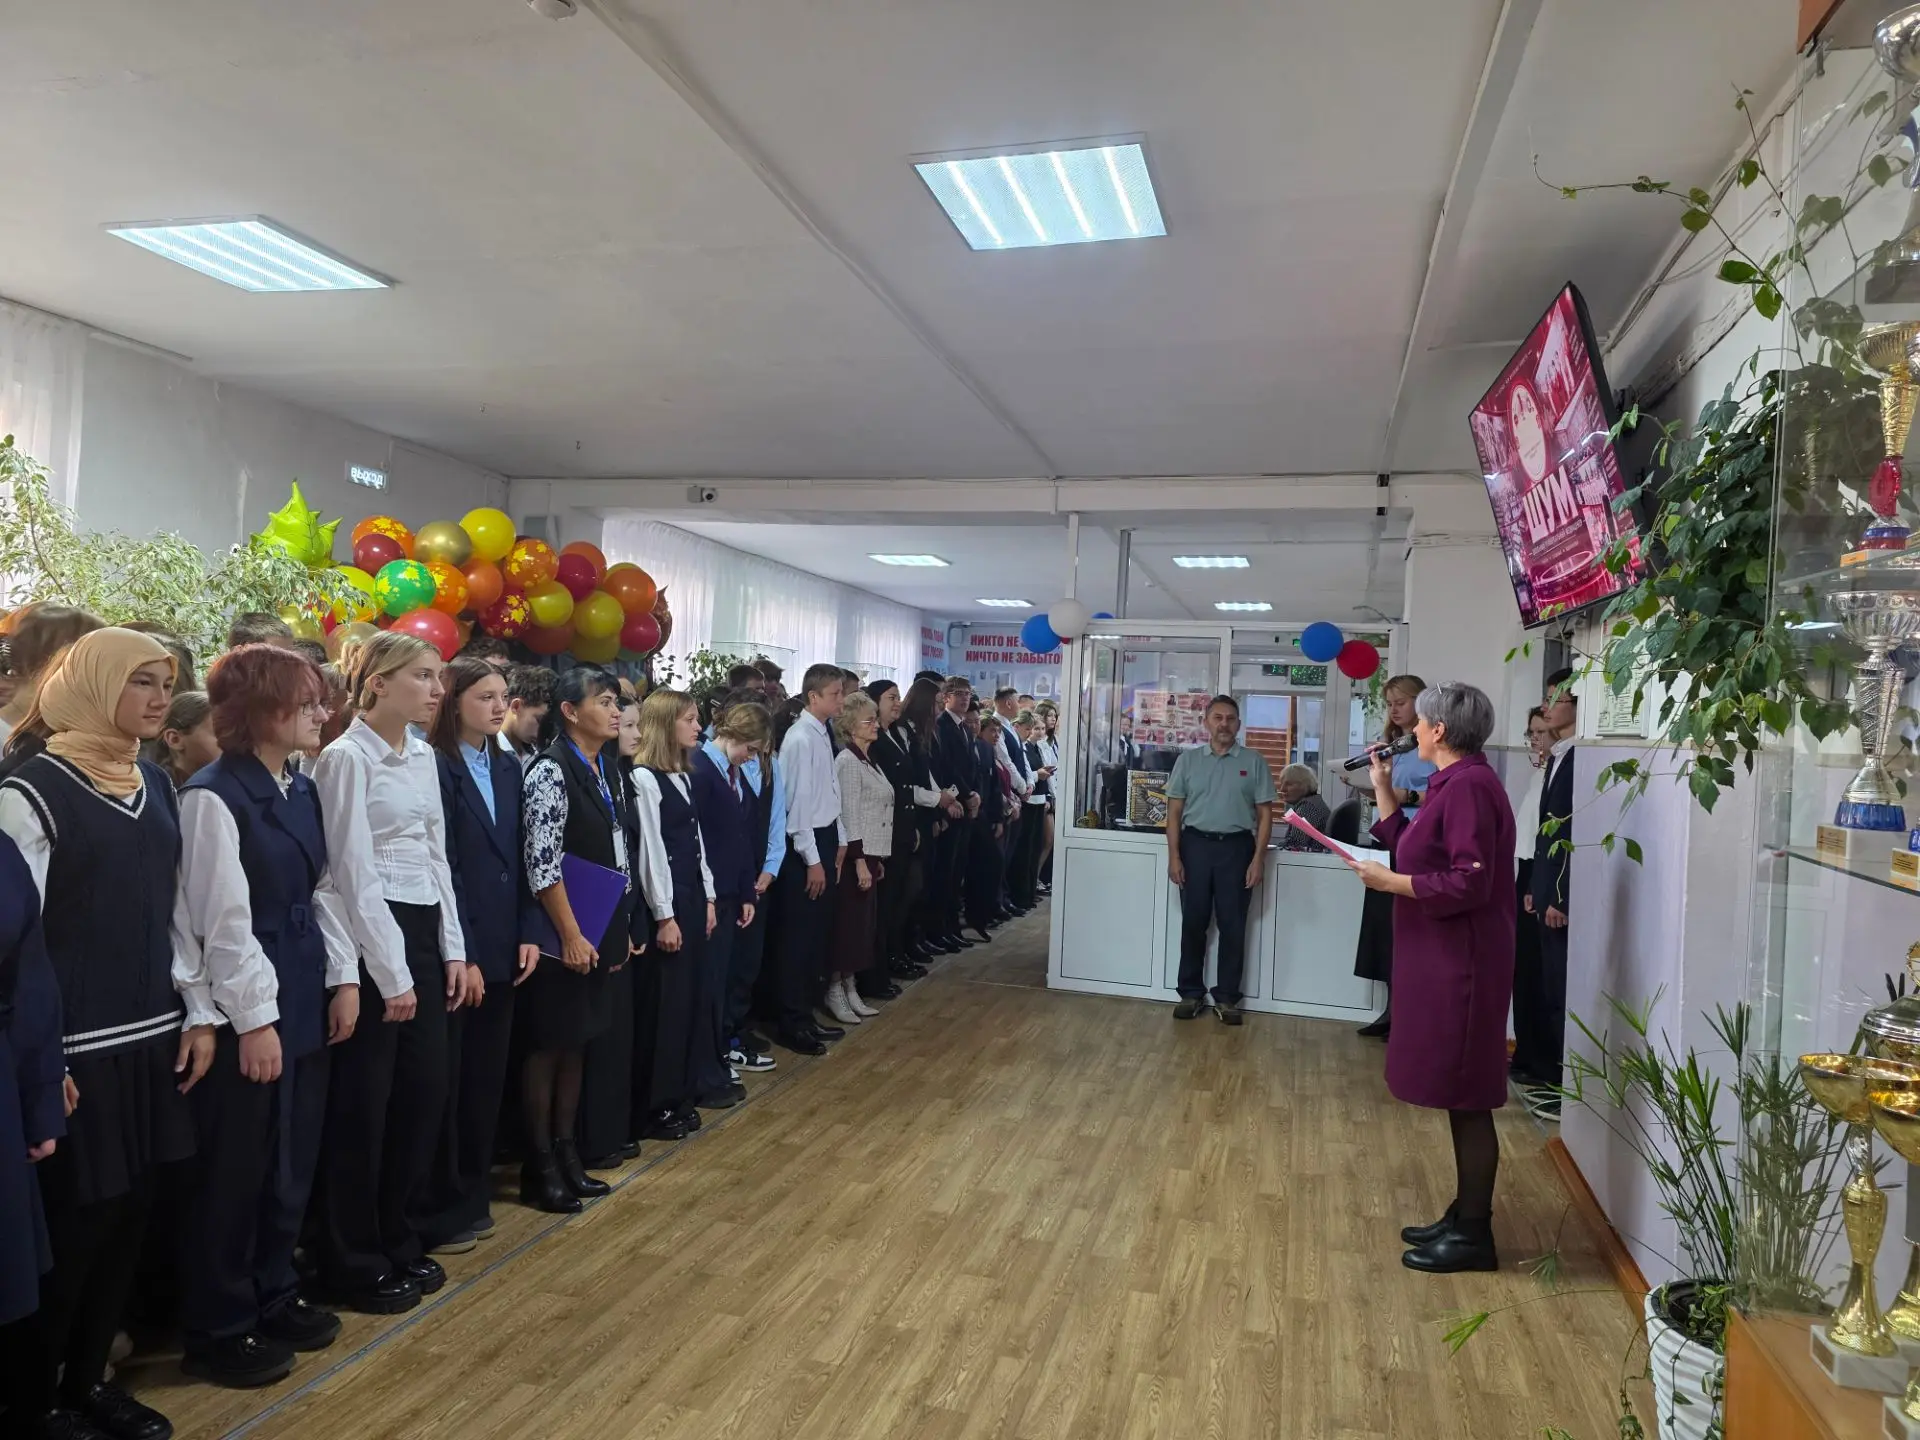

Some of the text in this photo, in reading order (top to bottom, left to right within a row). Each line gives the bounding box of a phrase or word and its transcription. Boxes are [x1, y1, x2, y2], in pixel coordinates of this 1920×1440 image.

[351, 467, 384, 486] ВЫХОД
[1522, 464, 1579, 544] ШУМ
[970, 634, 1004, 647] НИКТО
[1006, 635, 1019, 648] НЕ
[966, 650, 999, 663] НИЧТО
[1001, 651, 1014, 663] НЕ
